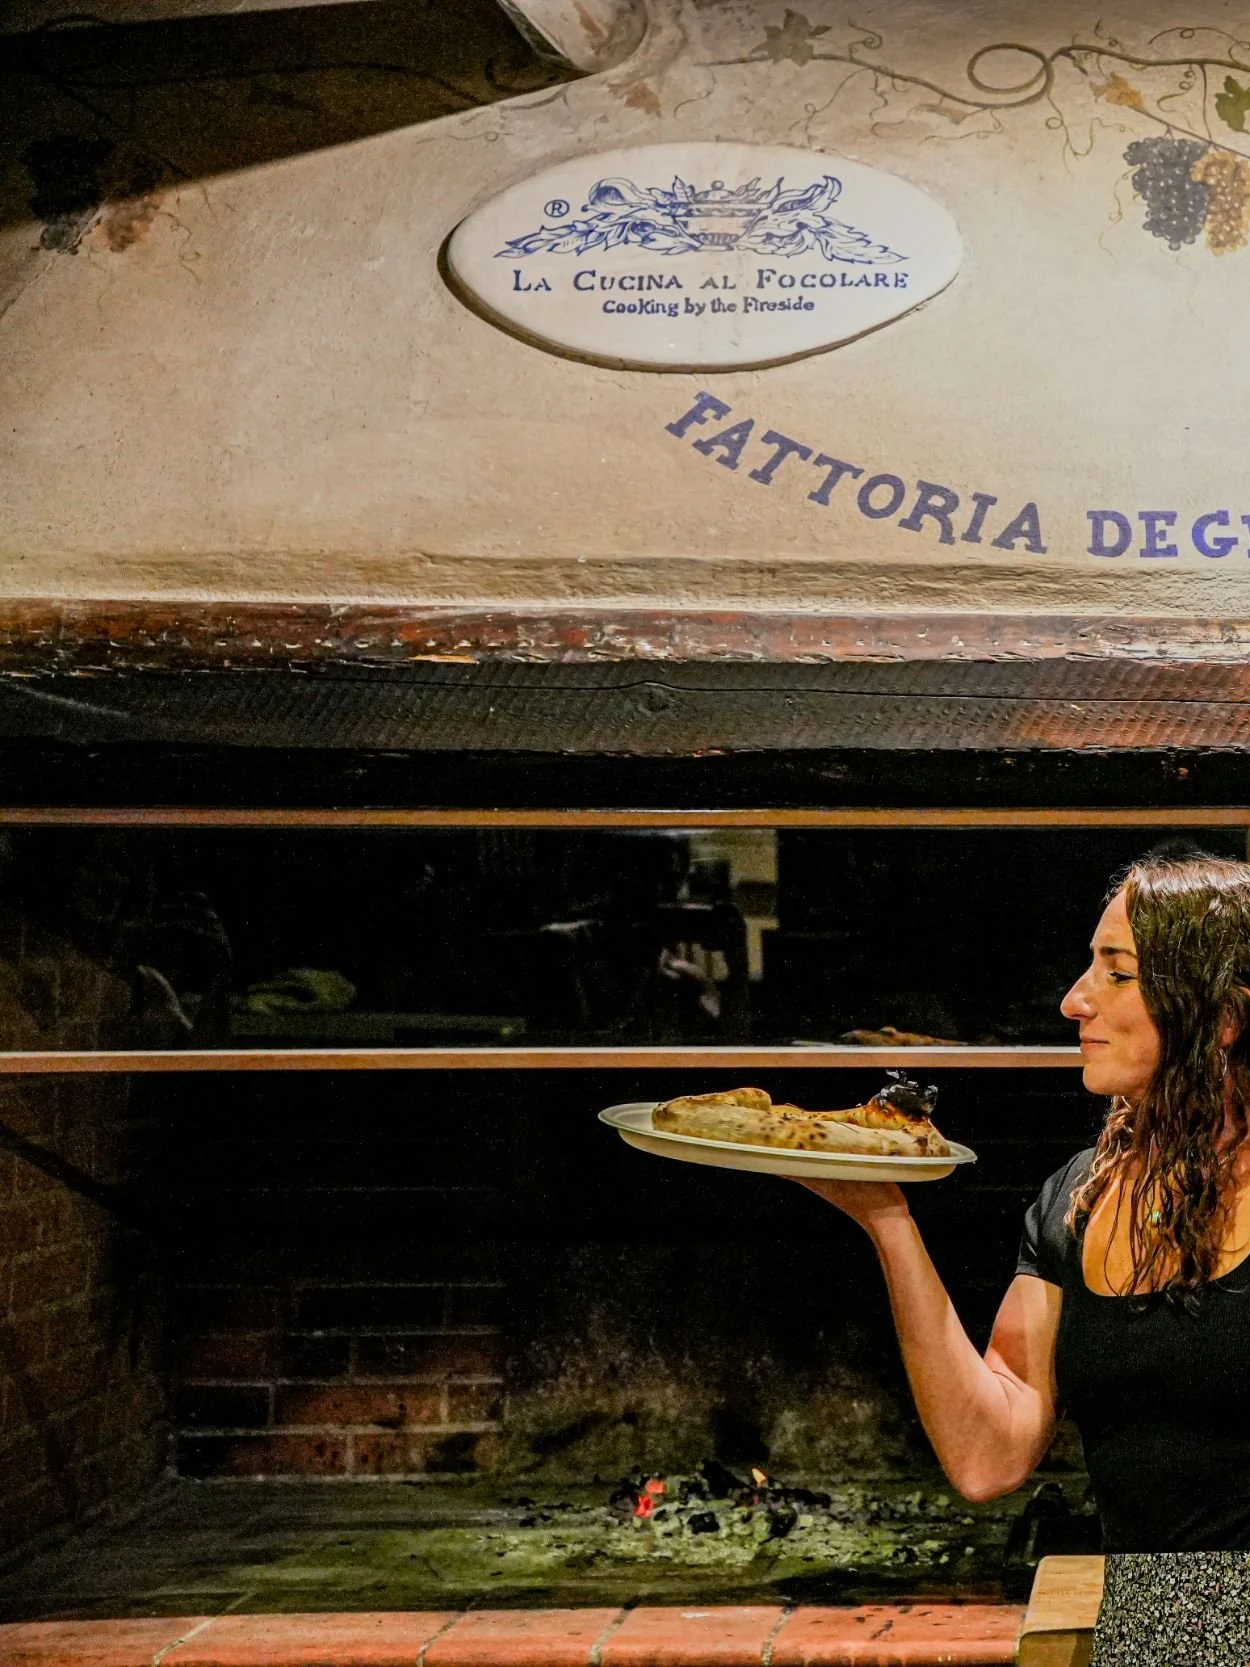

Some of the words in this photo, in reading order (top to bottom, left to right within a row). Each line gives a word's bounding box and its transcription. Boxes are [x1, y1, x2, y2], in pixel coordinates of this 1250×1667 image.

[602, 297, 679, 317] Cooking
[684, 297, 704, 318] by
[709, 297, 736, 313] the
[743, 296, 815, 314] Fireside
[664, 391, 1048, 552] FATTORIA
